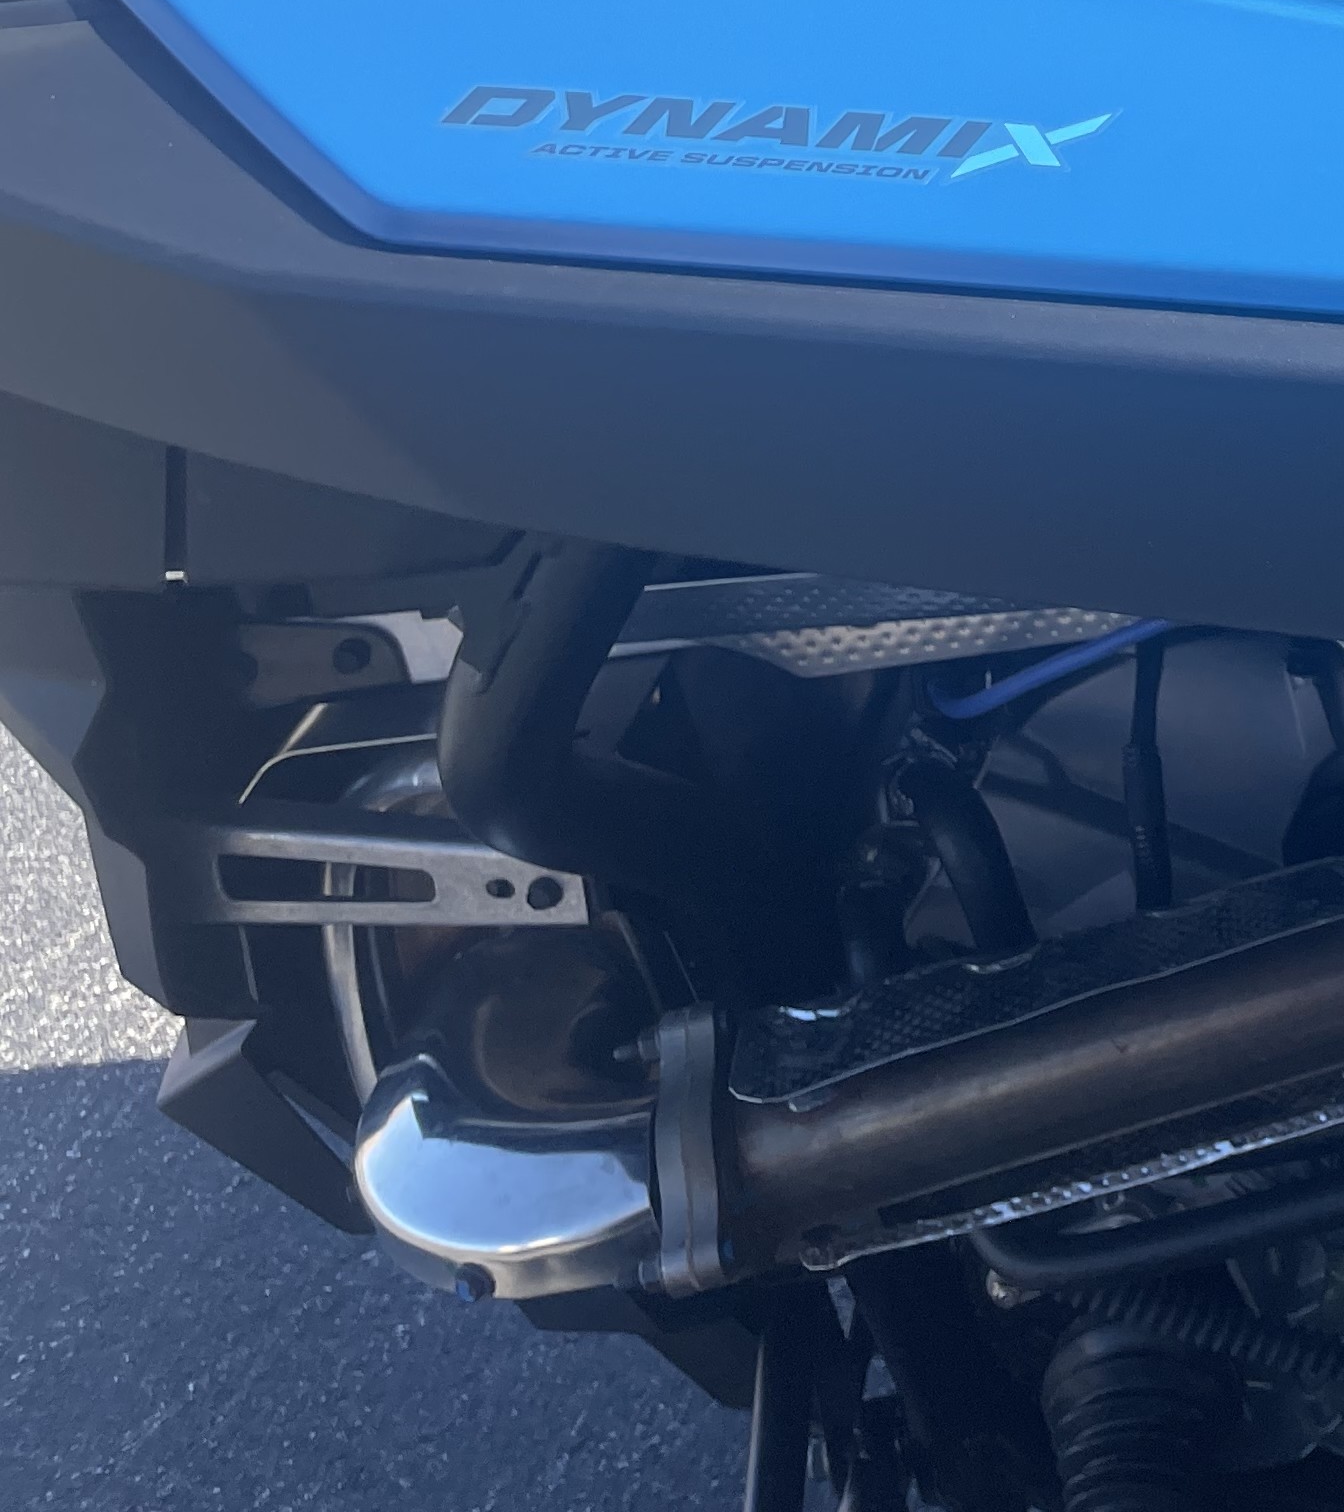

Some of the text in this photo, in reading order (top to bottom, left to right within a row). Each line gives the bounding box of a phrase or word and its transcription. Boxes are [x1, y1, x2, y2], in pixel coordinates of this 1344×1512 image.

[441, 86, 1112, 179] DYNAMIX
[534, 142, 930, 180] ACTIVE SUSPENSION
